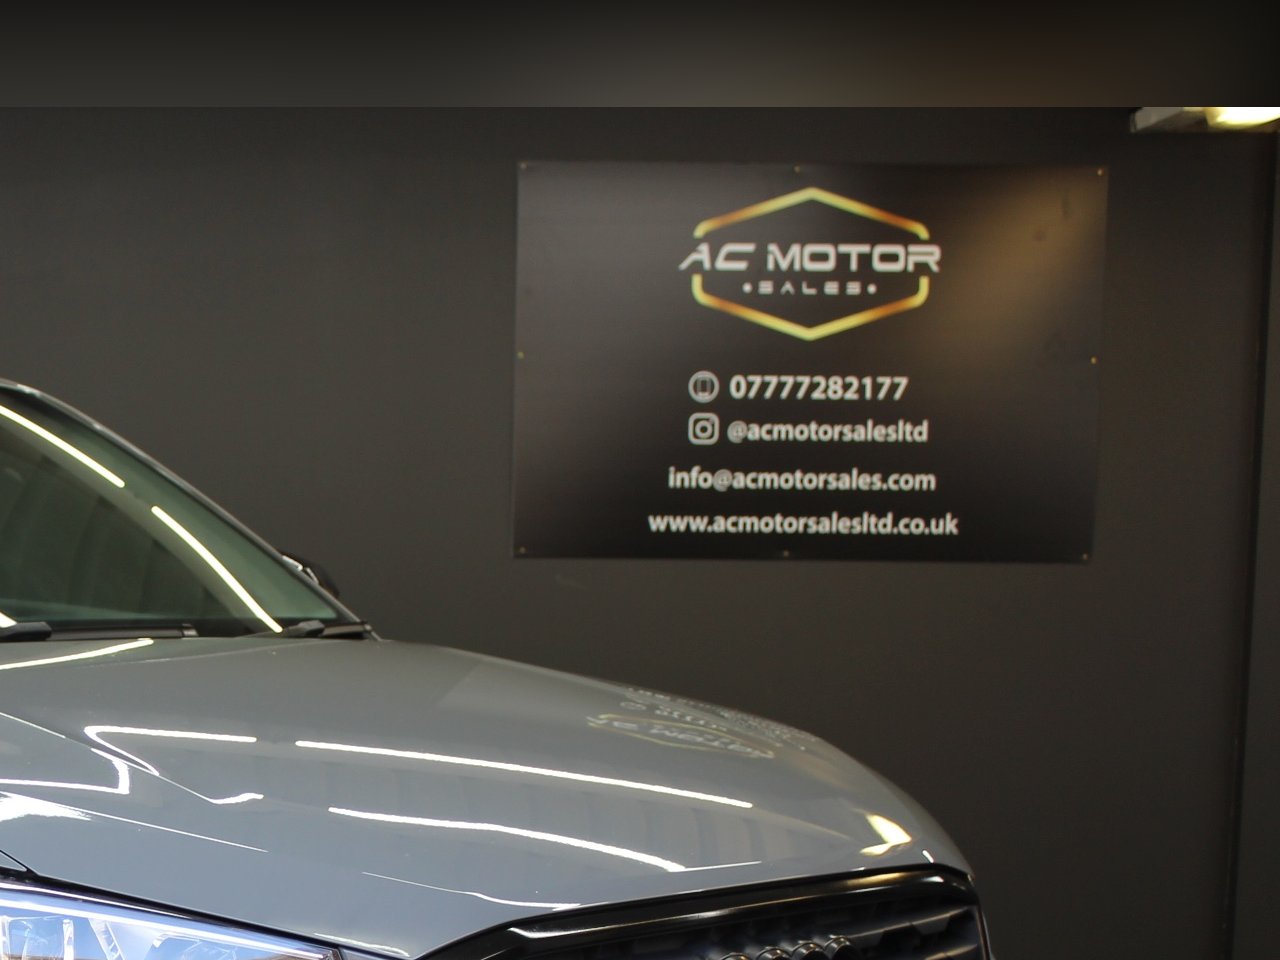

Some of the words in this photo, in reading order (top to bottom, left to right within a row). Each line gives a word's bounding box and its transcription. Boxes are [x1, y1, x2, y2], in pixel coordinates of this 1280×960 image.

[679, 242, 755, 271] AC
[767, 243, 941, 273] MOTOR
[757, 280, 863, 296] SALES
[729, 375, 909, 400] 07777282177
[726, 419, 929, 444] @acmotorsalesltd
[668, 466, 937, 492] info@acmotorsales.com
[648, 511, 959, 537] www.acmotorsalesltd.co.uk
